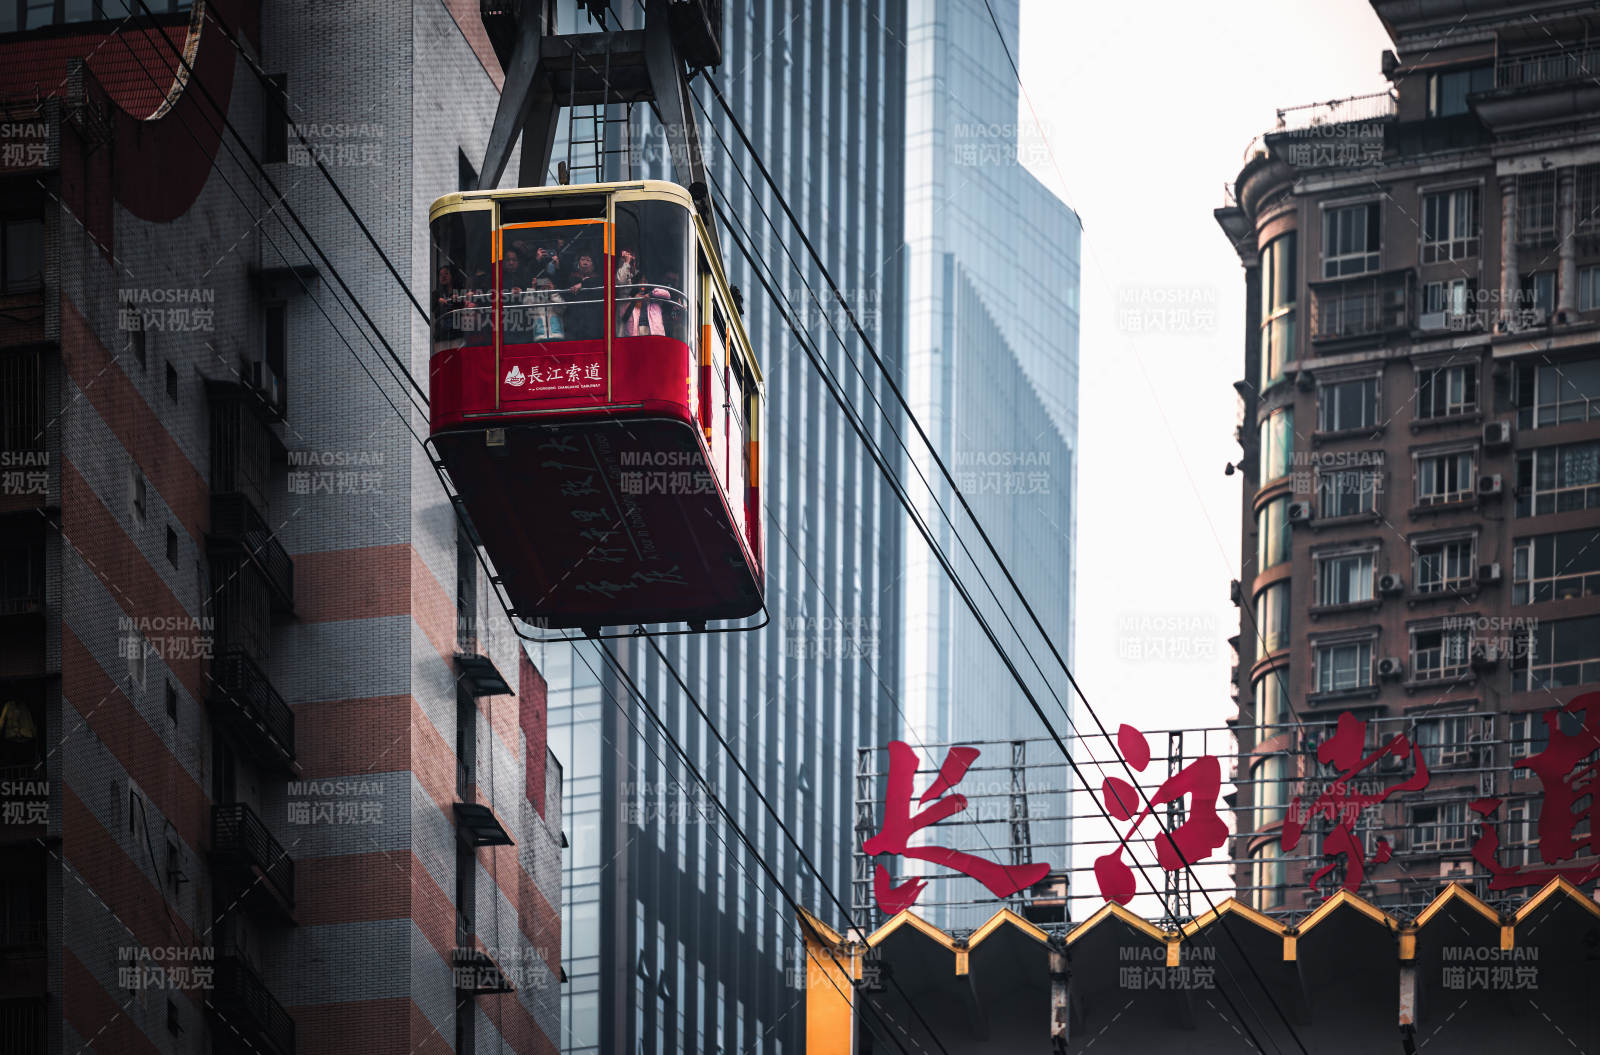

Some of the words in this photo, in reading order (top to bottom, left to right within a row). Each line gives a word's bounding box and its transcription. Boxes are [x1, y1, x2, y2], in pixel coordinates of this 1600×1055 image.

[528, 362, 603, 384] 長江索道
[864, 692, 1600, 914] 长江索道
